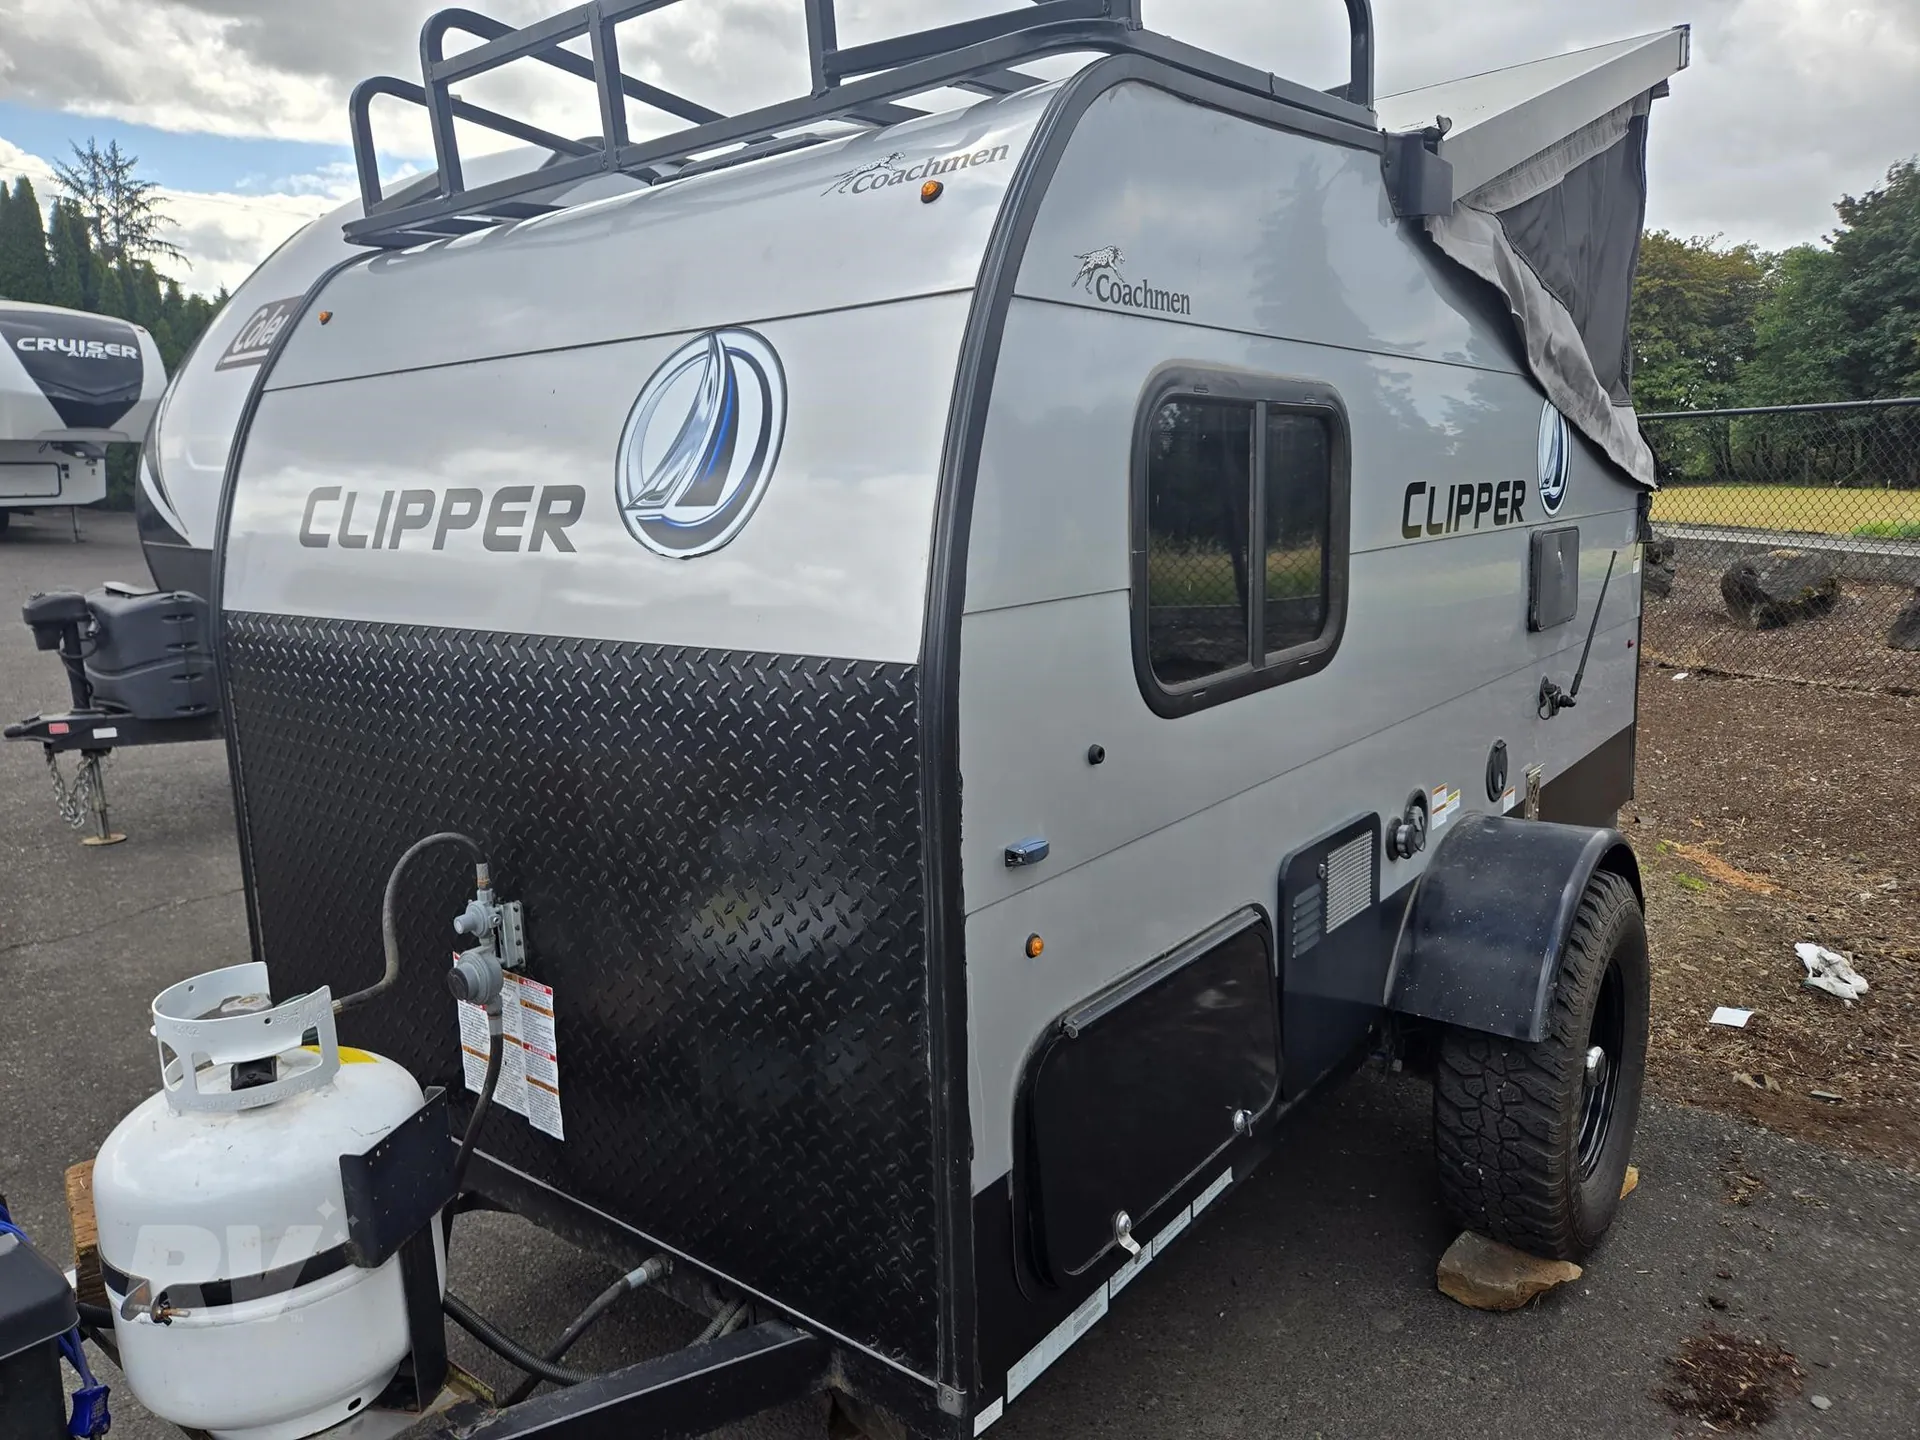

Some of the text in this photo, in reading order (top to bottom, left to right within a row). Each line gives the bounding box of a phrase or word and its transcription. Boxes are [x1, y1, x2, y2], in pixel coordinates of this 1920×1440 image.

[851, 144, 1010, 194] Coachmen
[1096, 273, 1191, 315] Coachmen
[16, 337, 139, 359] CRUISER
[299, 485, 586, 553] CLIPPER
[1402, 480, 1526, 539] CLIPPER
